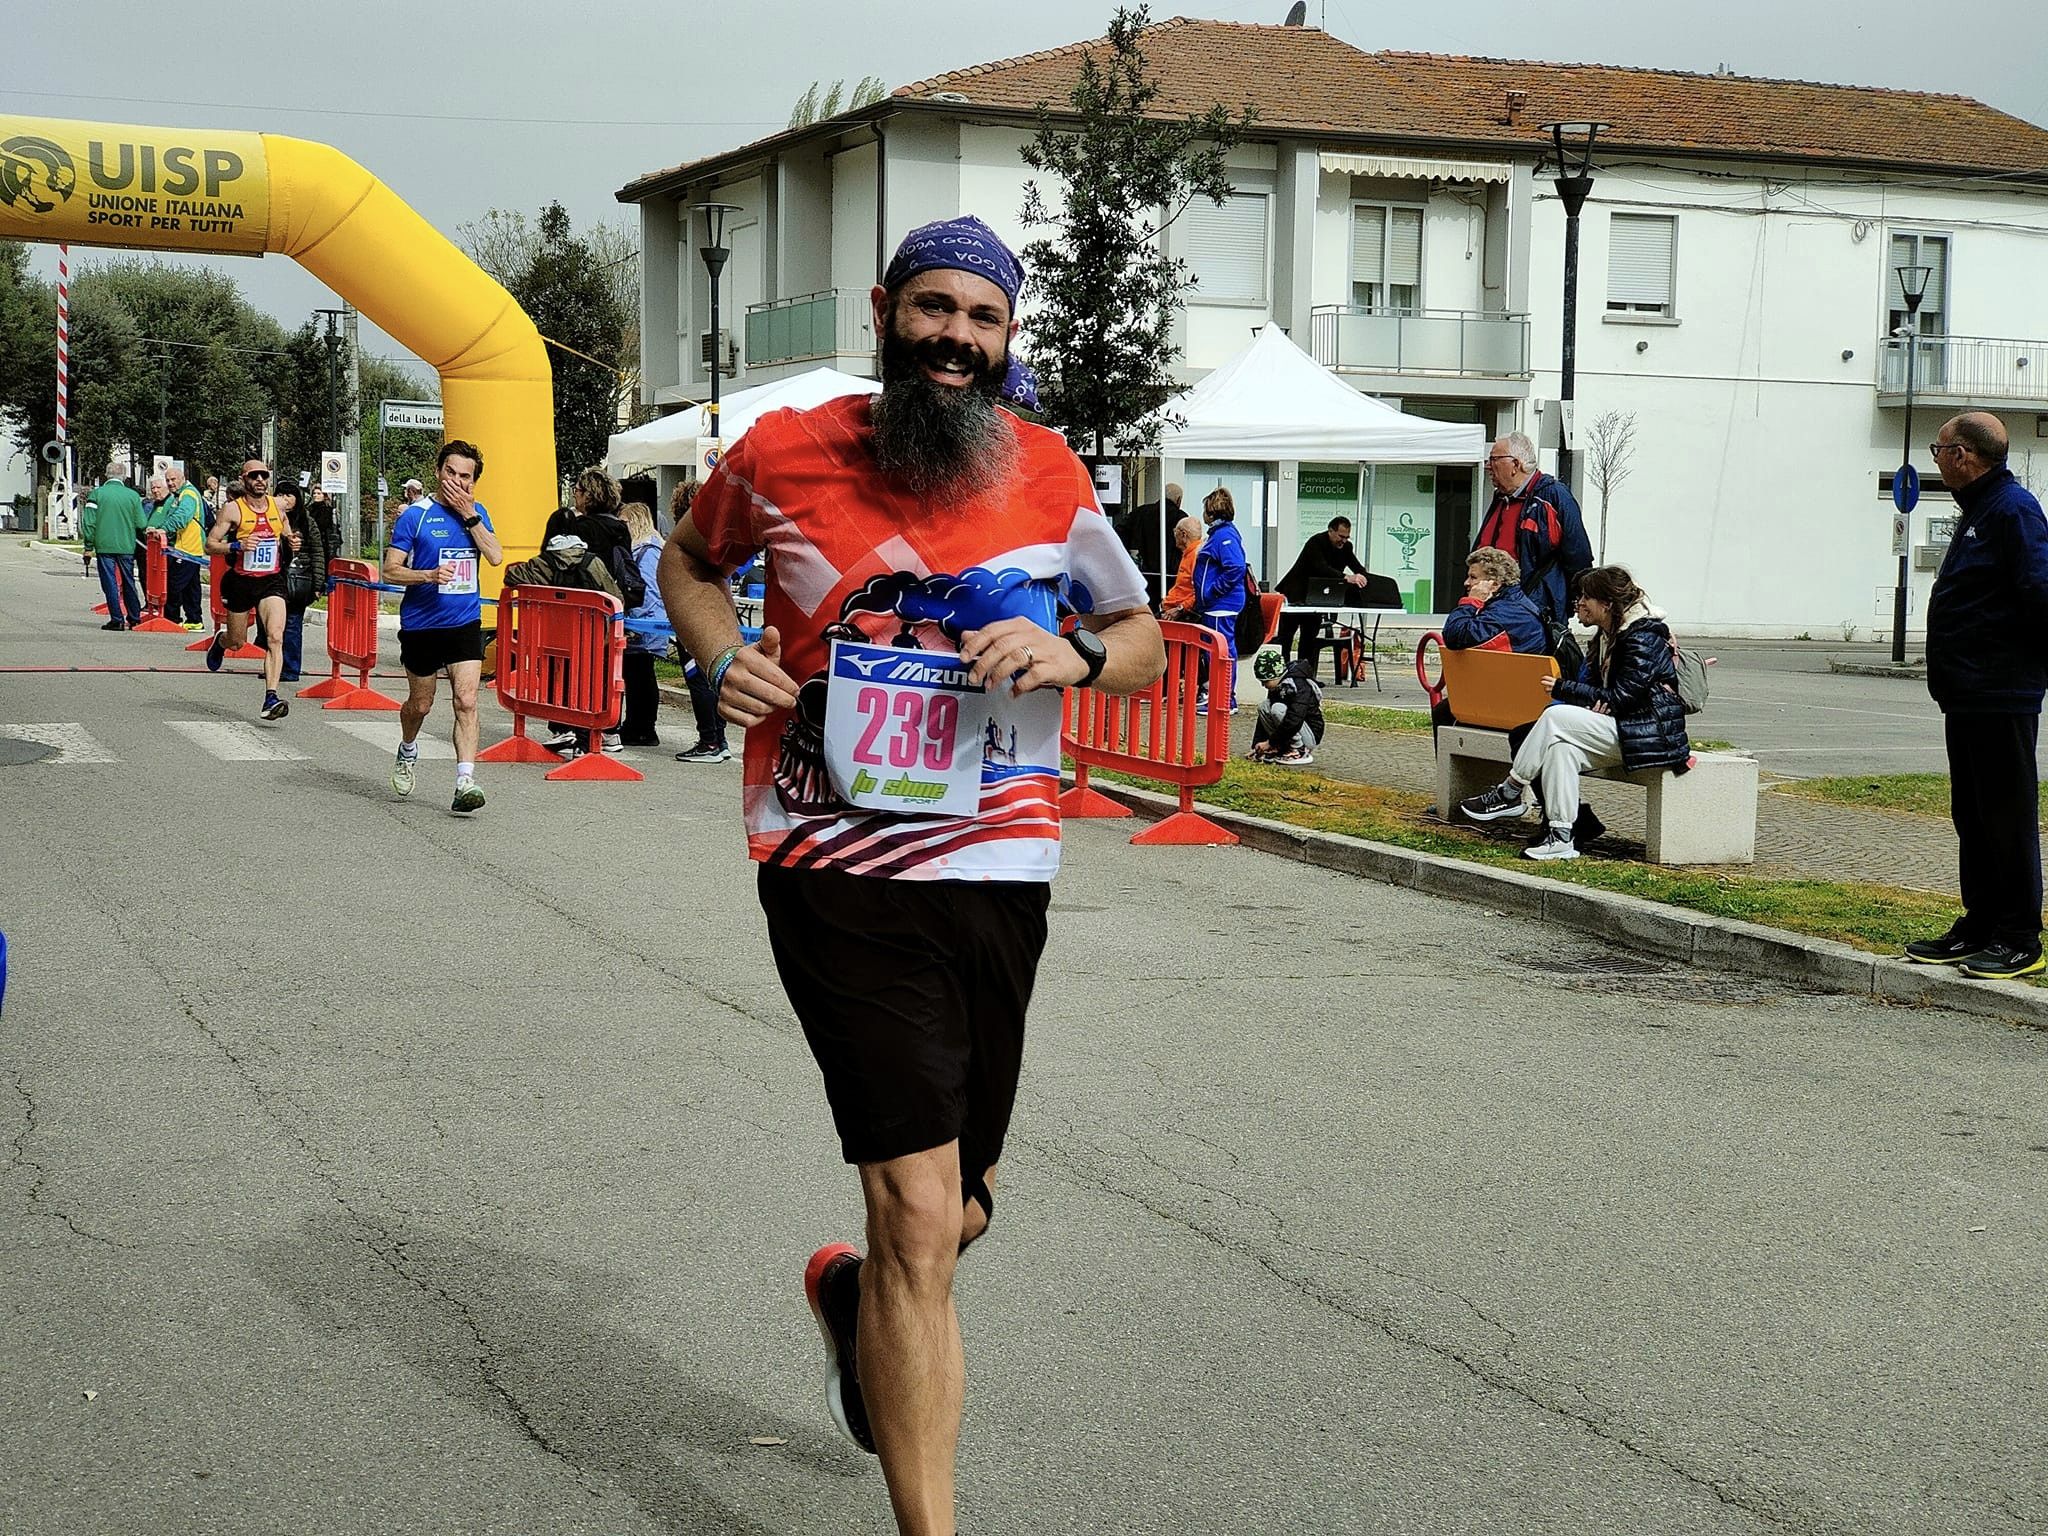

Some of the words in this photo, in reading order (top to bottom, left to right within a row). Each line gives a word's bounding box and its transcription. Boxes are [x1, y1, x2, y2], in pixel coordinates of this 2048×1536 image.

[88, 140, 244, 198] UISP
[88, 193, 158, 213] UNIONE
[165, 199, 244, 219] ITALIANA
[87, 211, 143, 228] SPORT
[150, 216, 181, 231] PER
[190, 219, 234, 234] TUTTI
[948, 222, 983, 235] GOA
[942, 236, 985, 250] GOA
[954, 250, 996, 271] GOA
[388, 413, 411, 423] della
[1300, 483, 1346, 494] Farmacia
[253, 547, 272, 563] 195
[853, 686, 960, 772] 239
[902, 797, 939, 806] SPORT
